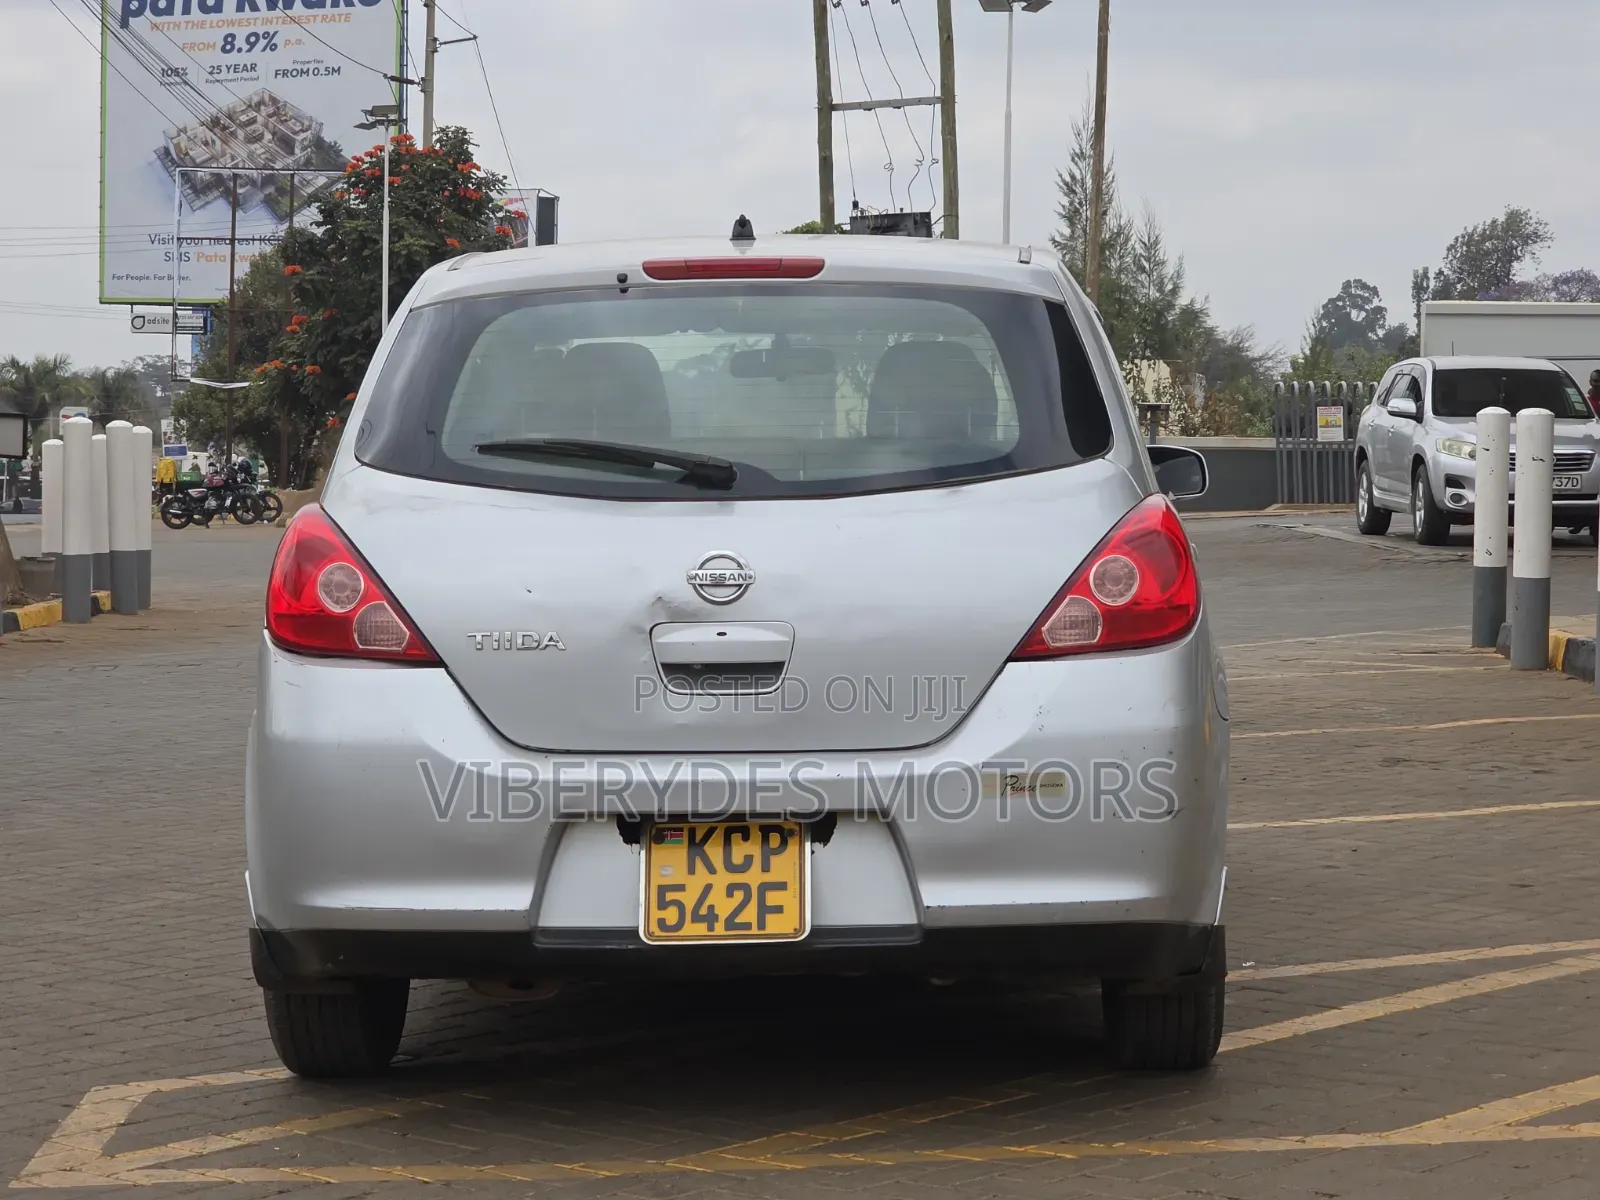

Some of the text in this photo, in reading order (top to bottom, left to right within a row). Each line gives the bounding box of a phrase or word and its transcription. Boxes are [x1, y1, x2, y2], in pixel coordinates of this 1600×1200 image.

[150, 12, 352, 32] WITH THE LOWEST INTEREST RATE
[181, 30, 305, 55] FROM 8.9% p.a.
[209, 62, 258, 75] 25 YEAR
[292, 58, 324, 66] Properties
[161, 66, 188, 78] 105%
[274, 65, 342, 79] FROM 0.5M
[205, 77, 239, 85] Repayment
[148, 233, 174, 246] Visit
[112, 273, 124, 281] For
[126, 273, 152, 282] People.
[154, 273, 166, 281] For
[147, 316, 170, 325] adsite
[694, 572, 747, 583] NISSAN
[467, 631, 566, 650] TIIDA
[1001, 775, 1037, 796] Prince
[687, 825, 789, 876] KCP
[656, 881, 788, 933] 542F
